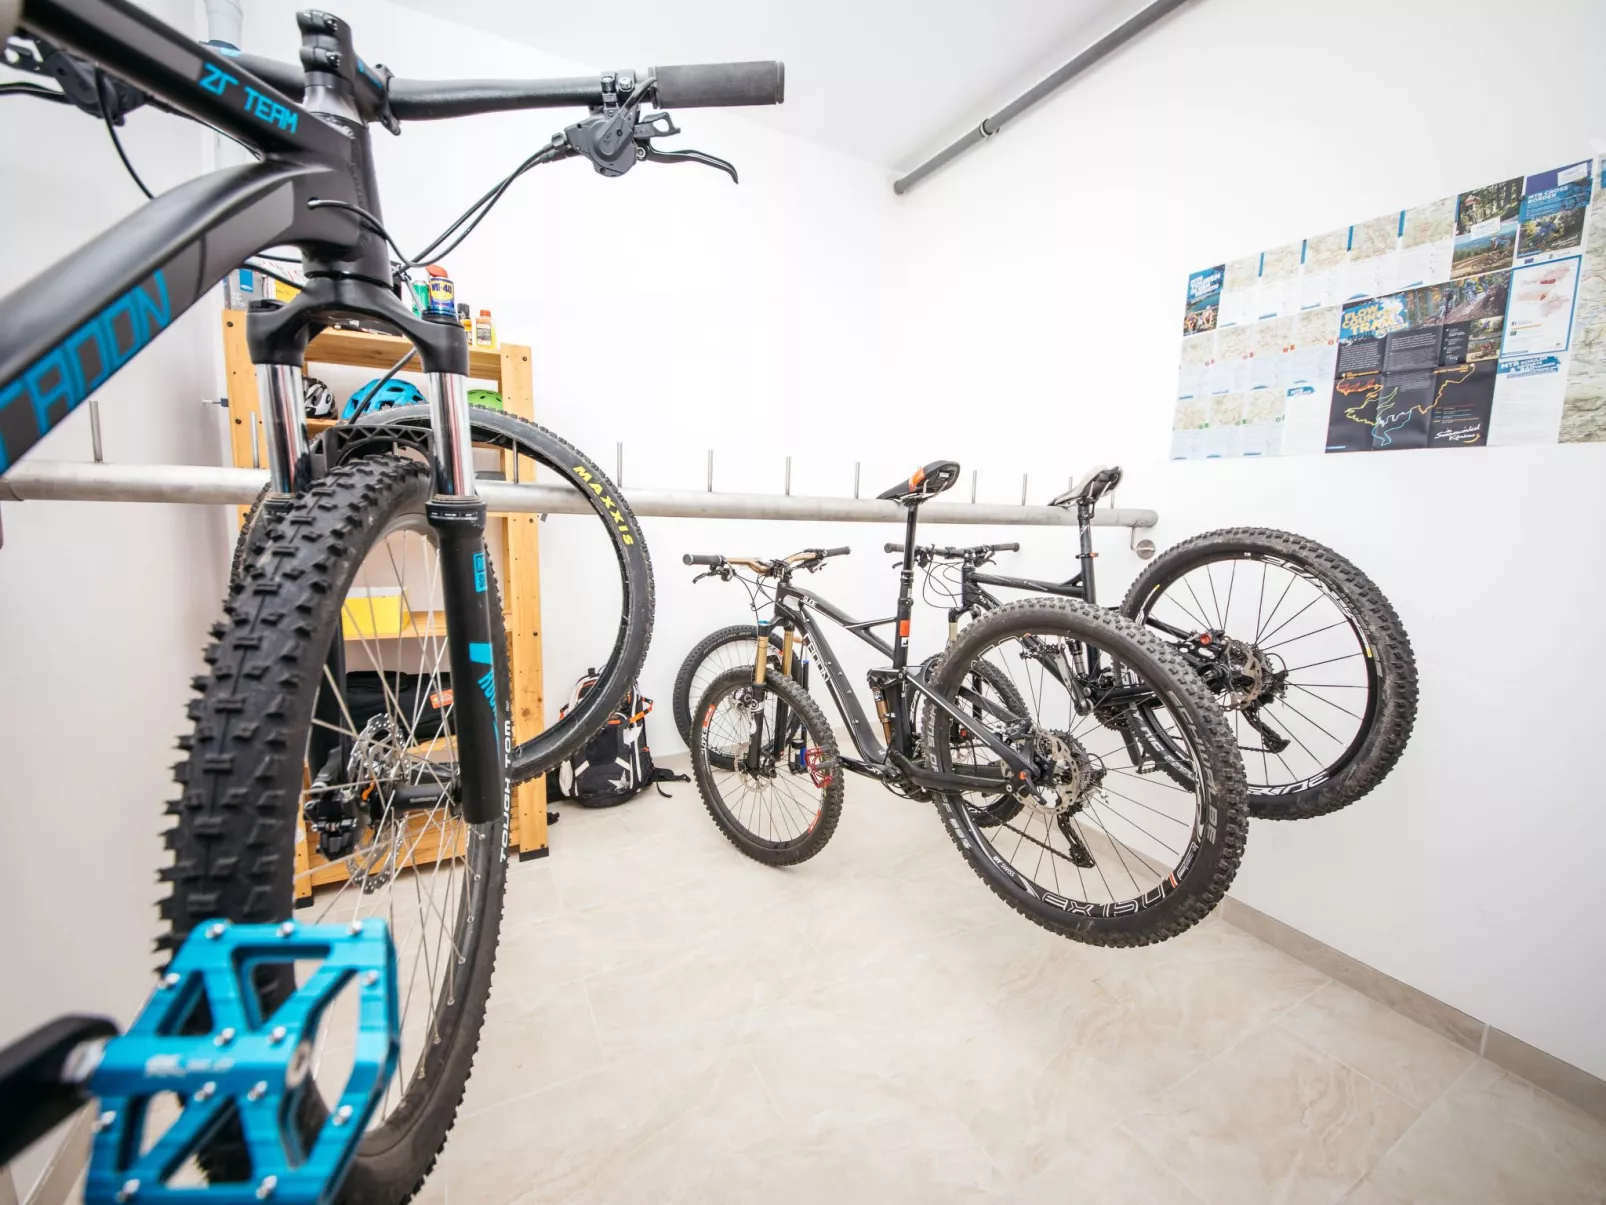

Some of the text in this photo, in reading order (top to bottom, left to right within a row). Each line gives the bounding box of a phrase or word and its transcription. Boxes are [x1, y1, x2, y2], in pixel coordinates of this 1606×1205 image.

[244, 86, 299, 134] TEAM
[431, 282, 452, 294] WD-40
[1344, 305, 1379, 321] FLOW
[573, 466, 634, 545] MAXXIS
[927, 703, 938, 749] HANS
[499, 778, 511, 864] TOUGH
[992, 855, 1015, 878] DT SWISS
